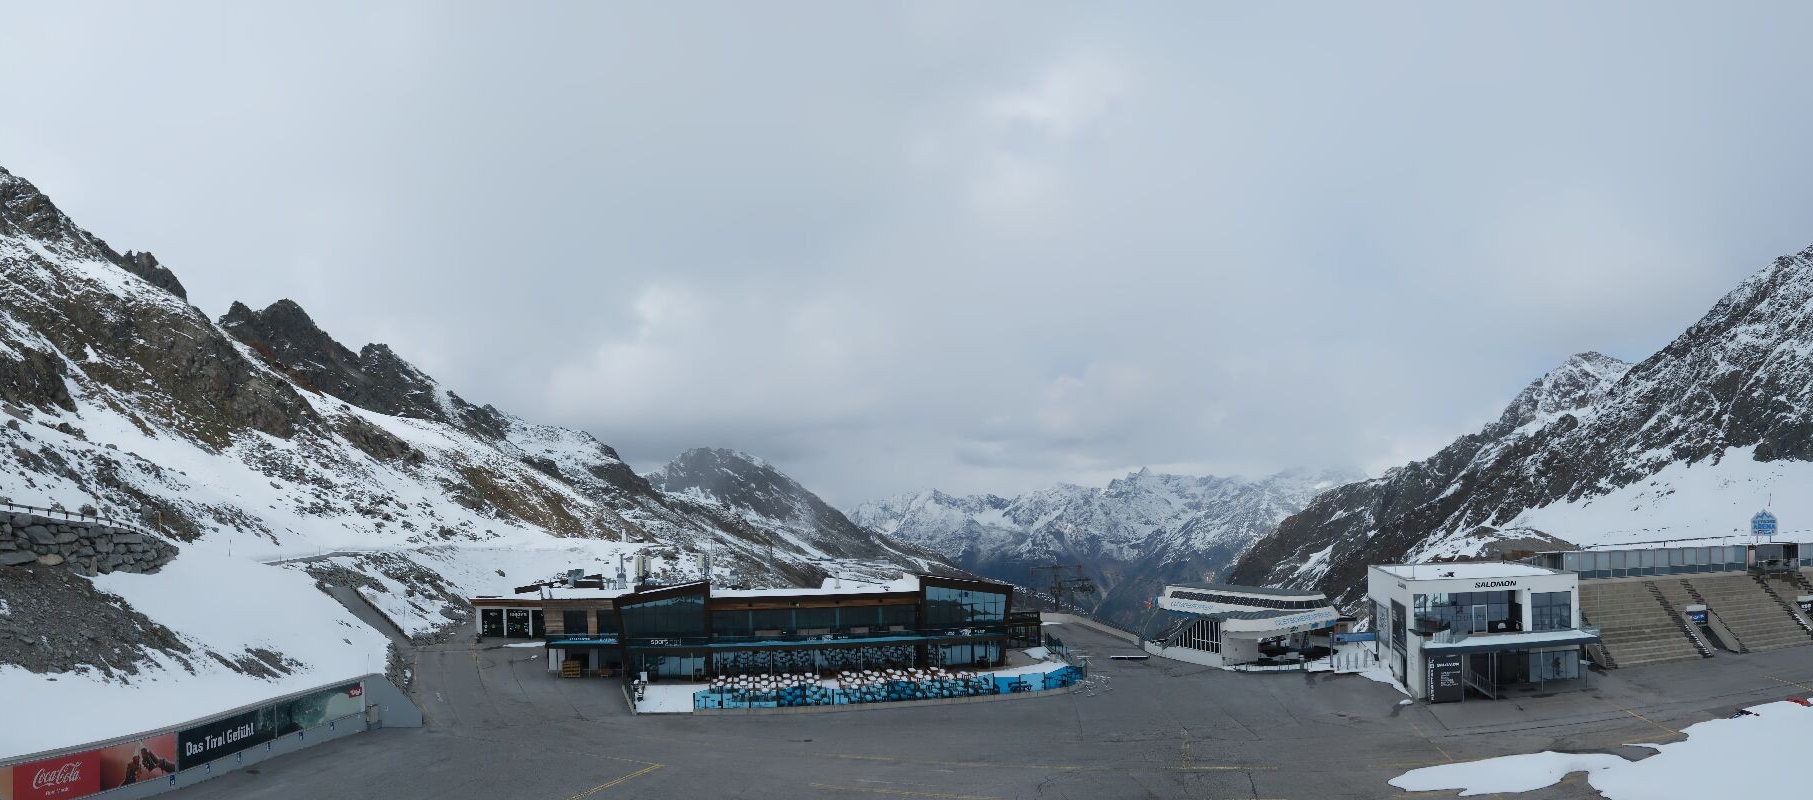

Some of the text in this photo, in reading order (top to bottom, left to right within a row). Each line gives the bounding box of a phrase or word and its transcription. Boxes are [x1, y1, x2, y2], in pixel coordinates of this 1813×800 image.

[1474, 580, 1517, 588] SALOMON
[186, 722, 255, 757] Das Tirol Gefühl
